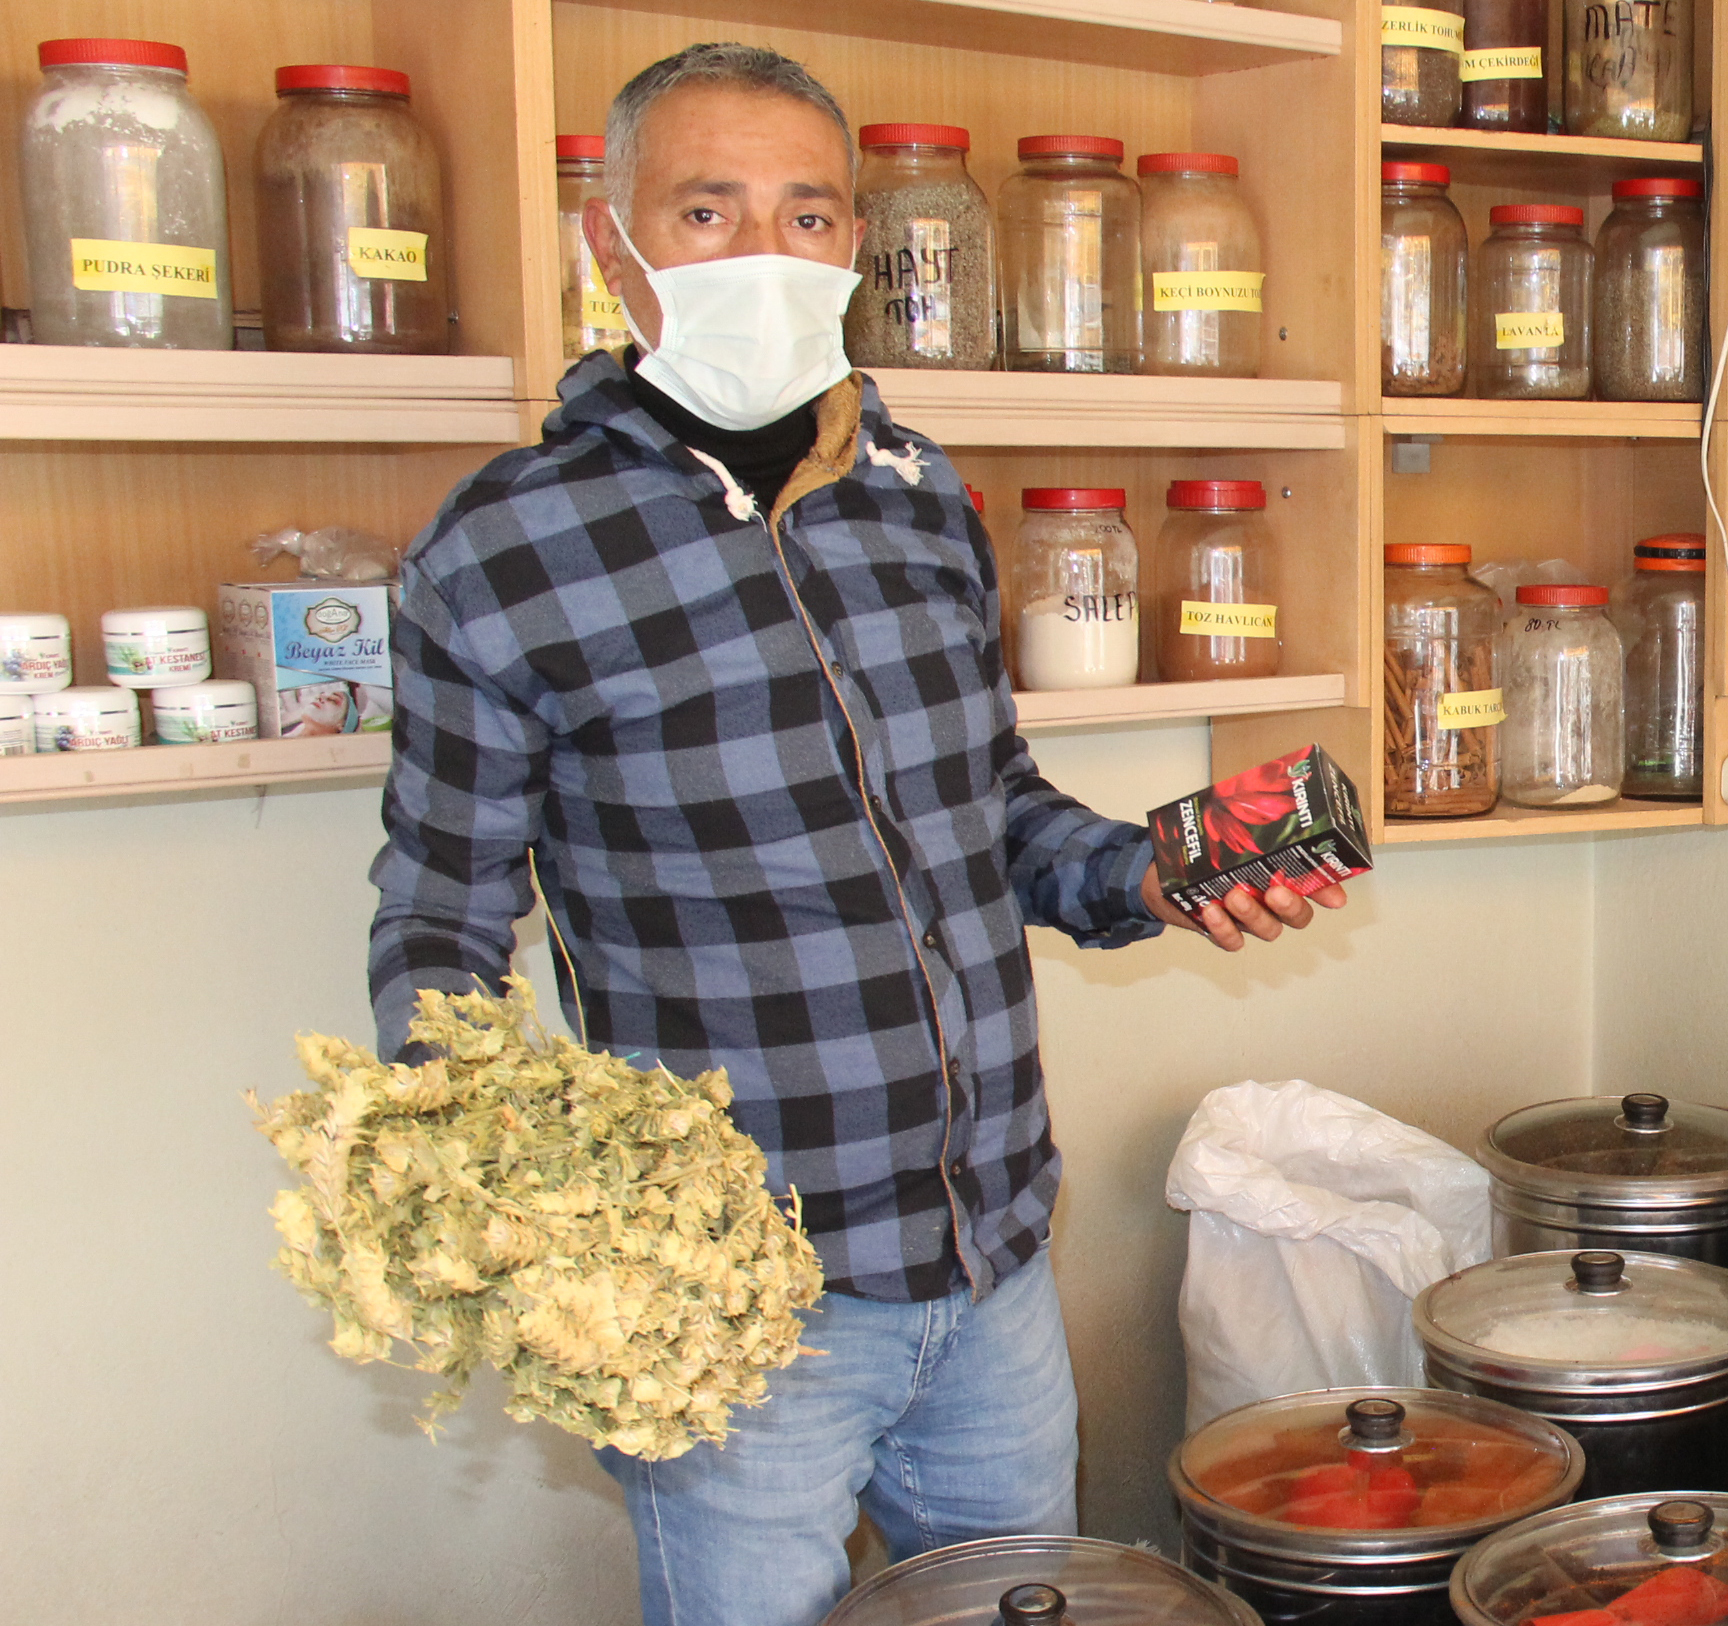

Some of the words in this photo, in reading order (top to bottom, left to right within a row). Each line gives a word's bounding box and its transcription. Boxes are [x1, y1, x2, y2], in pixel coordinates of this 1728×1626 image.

[1585, 0, 1677, 42] MATE
[359, 246, 417, 264] KAKAO
[82, 258, 147, 277] PUDRA
[151, 263, 210, 283] ŞEKERİ
[1160, 284, 1192, 299] KEÇİ
[1196, 286, 1249, 299] BOYNUZU
[590, 300, 622, 315] TUZ
[1187, 610, 1212, 623] TOZ
[1215, 613, 1274, 628] HAVLICAN
[285, 640, 347, 664] Beyaz
[352, 638, 385, 657] Kil
[1443, 704, 1482, 716] KABUK
[1291, 777, 1314, 828] KIRINTI
[1320, 851, 1353, 878] KIRINTI
